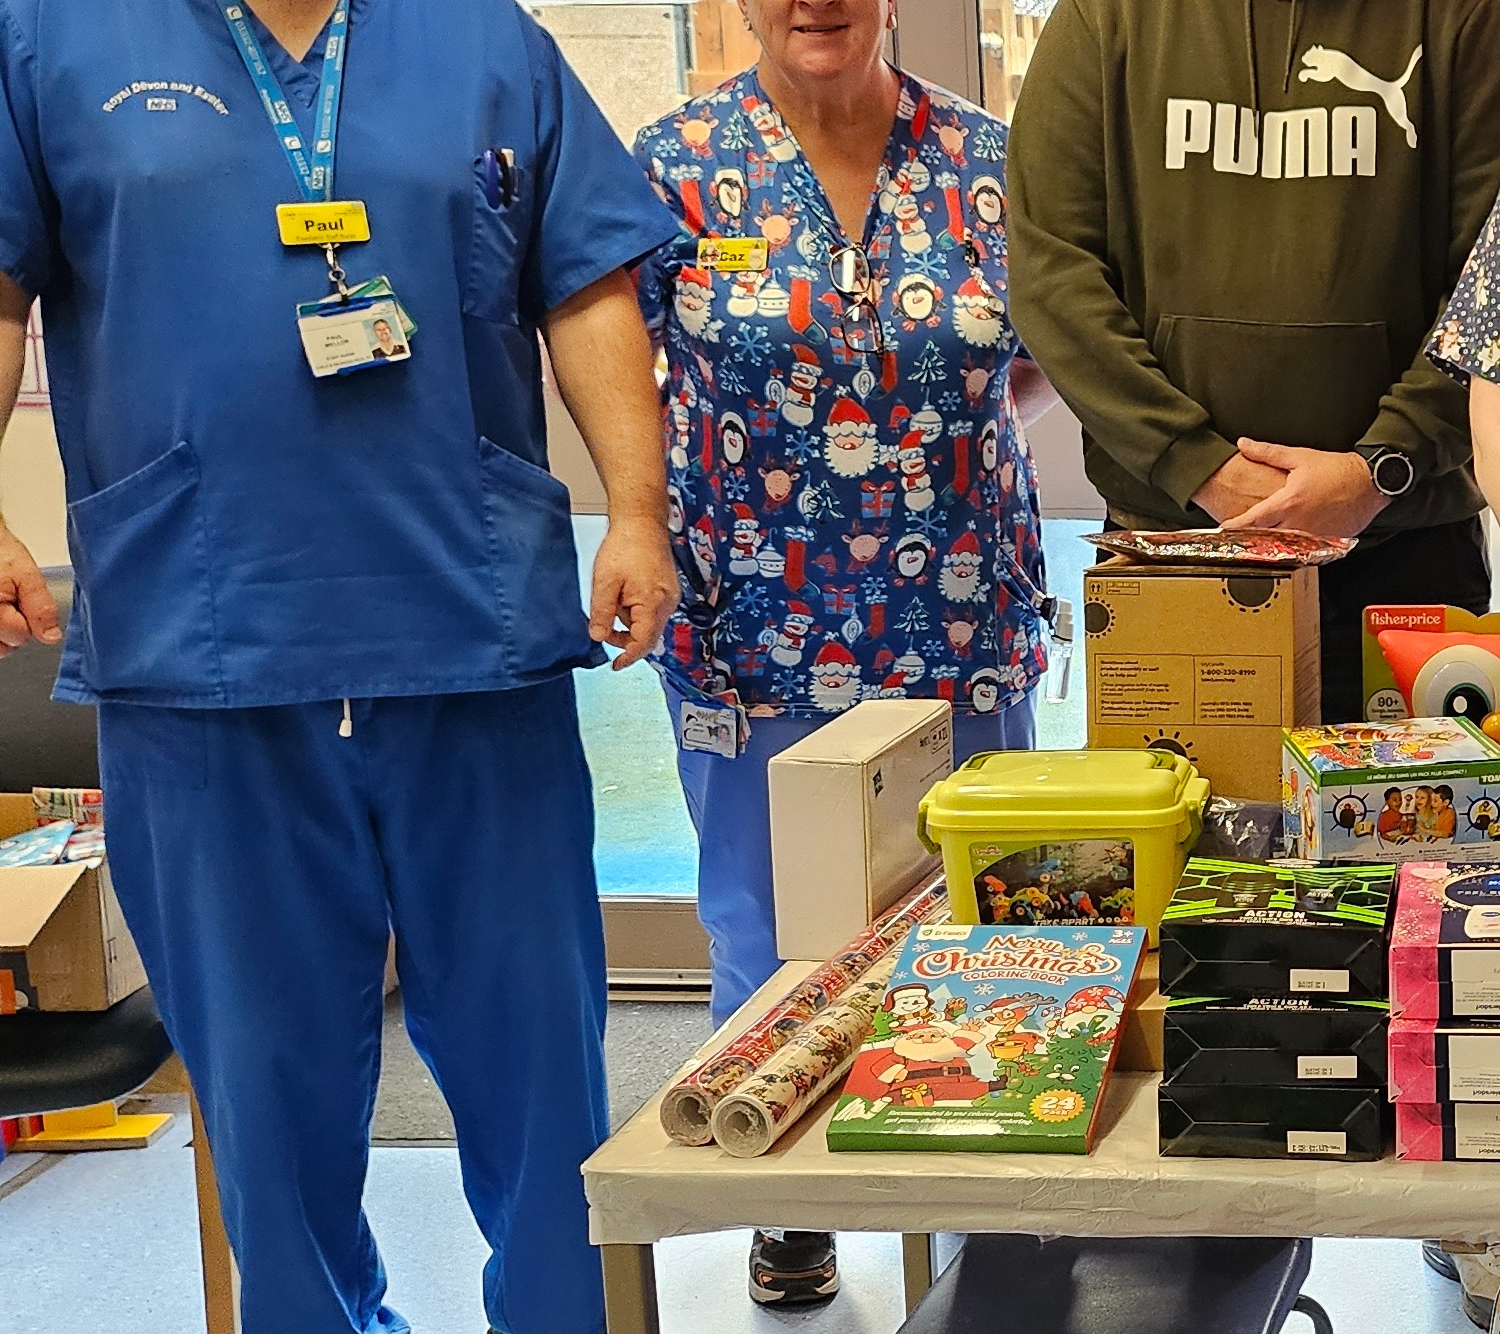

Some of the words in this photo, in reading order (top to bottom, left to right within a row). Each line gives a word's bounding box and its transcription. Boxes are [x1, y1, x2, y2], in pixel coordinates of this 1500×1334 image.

[103, 87, 132, 113] Royal
[131, 81, 168, 94] Devon
[170, 82, 193, 93] and
[194, 85, 229, 116] Exeter
[1165, 98, 1377, 179] PUMA
[305, 218, 344, 232] Paul
[720, 251, 745, 262] Caz
[1371, 612, 1441, 627] fisher-price
[1378, 696, 1399, 707] 90+
[1061, 917, 1095, 926] APART
[1245, 910, 1306, 919] ACTION
[988, 936, 1061, 953] Merry
[914, 948, 1120, 978] Christmas
[963, 971, 1030, 981] COLORING
[1030, 971, 1068, 985] BOOK
[1039, 1096, 1077, 1110] 24
